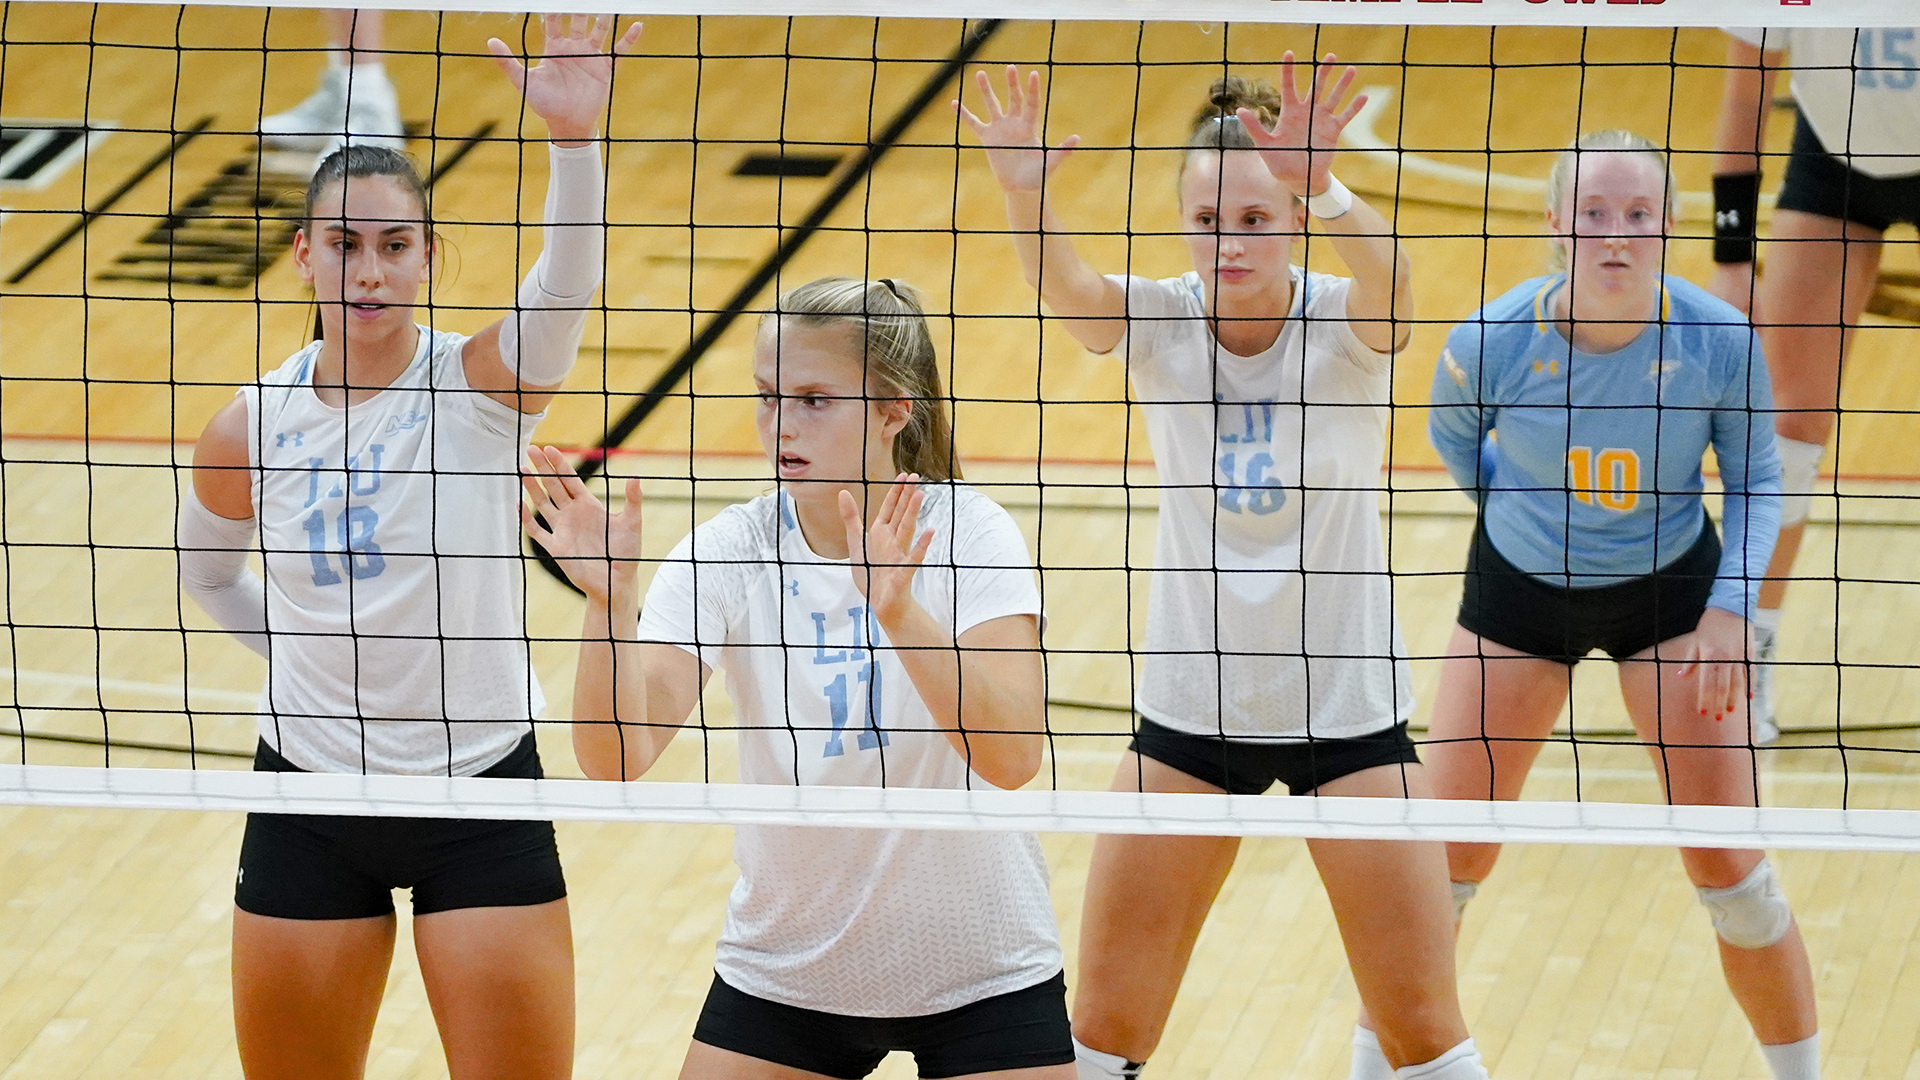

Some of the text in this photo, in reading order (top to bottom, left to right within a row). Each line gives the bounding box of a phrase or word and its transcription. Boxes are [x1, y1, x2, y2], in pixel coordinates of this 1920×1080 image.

[1857, 28, 1917, 89] 15
[1217, 452, 1287, 516] 16
[1566, 446, 1640, 513] 10
[302, 505, 386, 587] 18
[823, 660, 890, 758] 11
